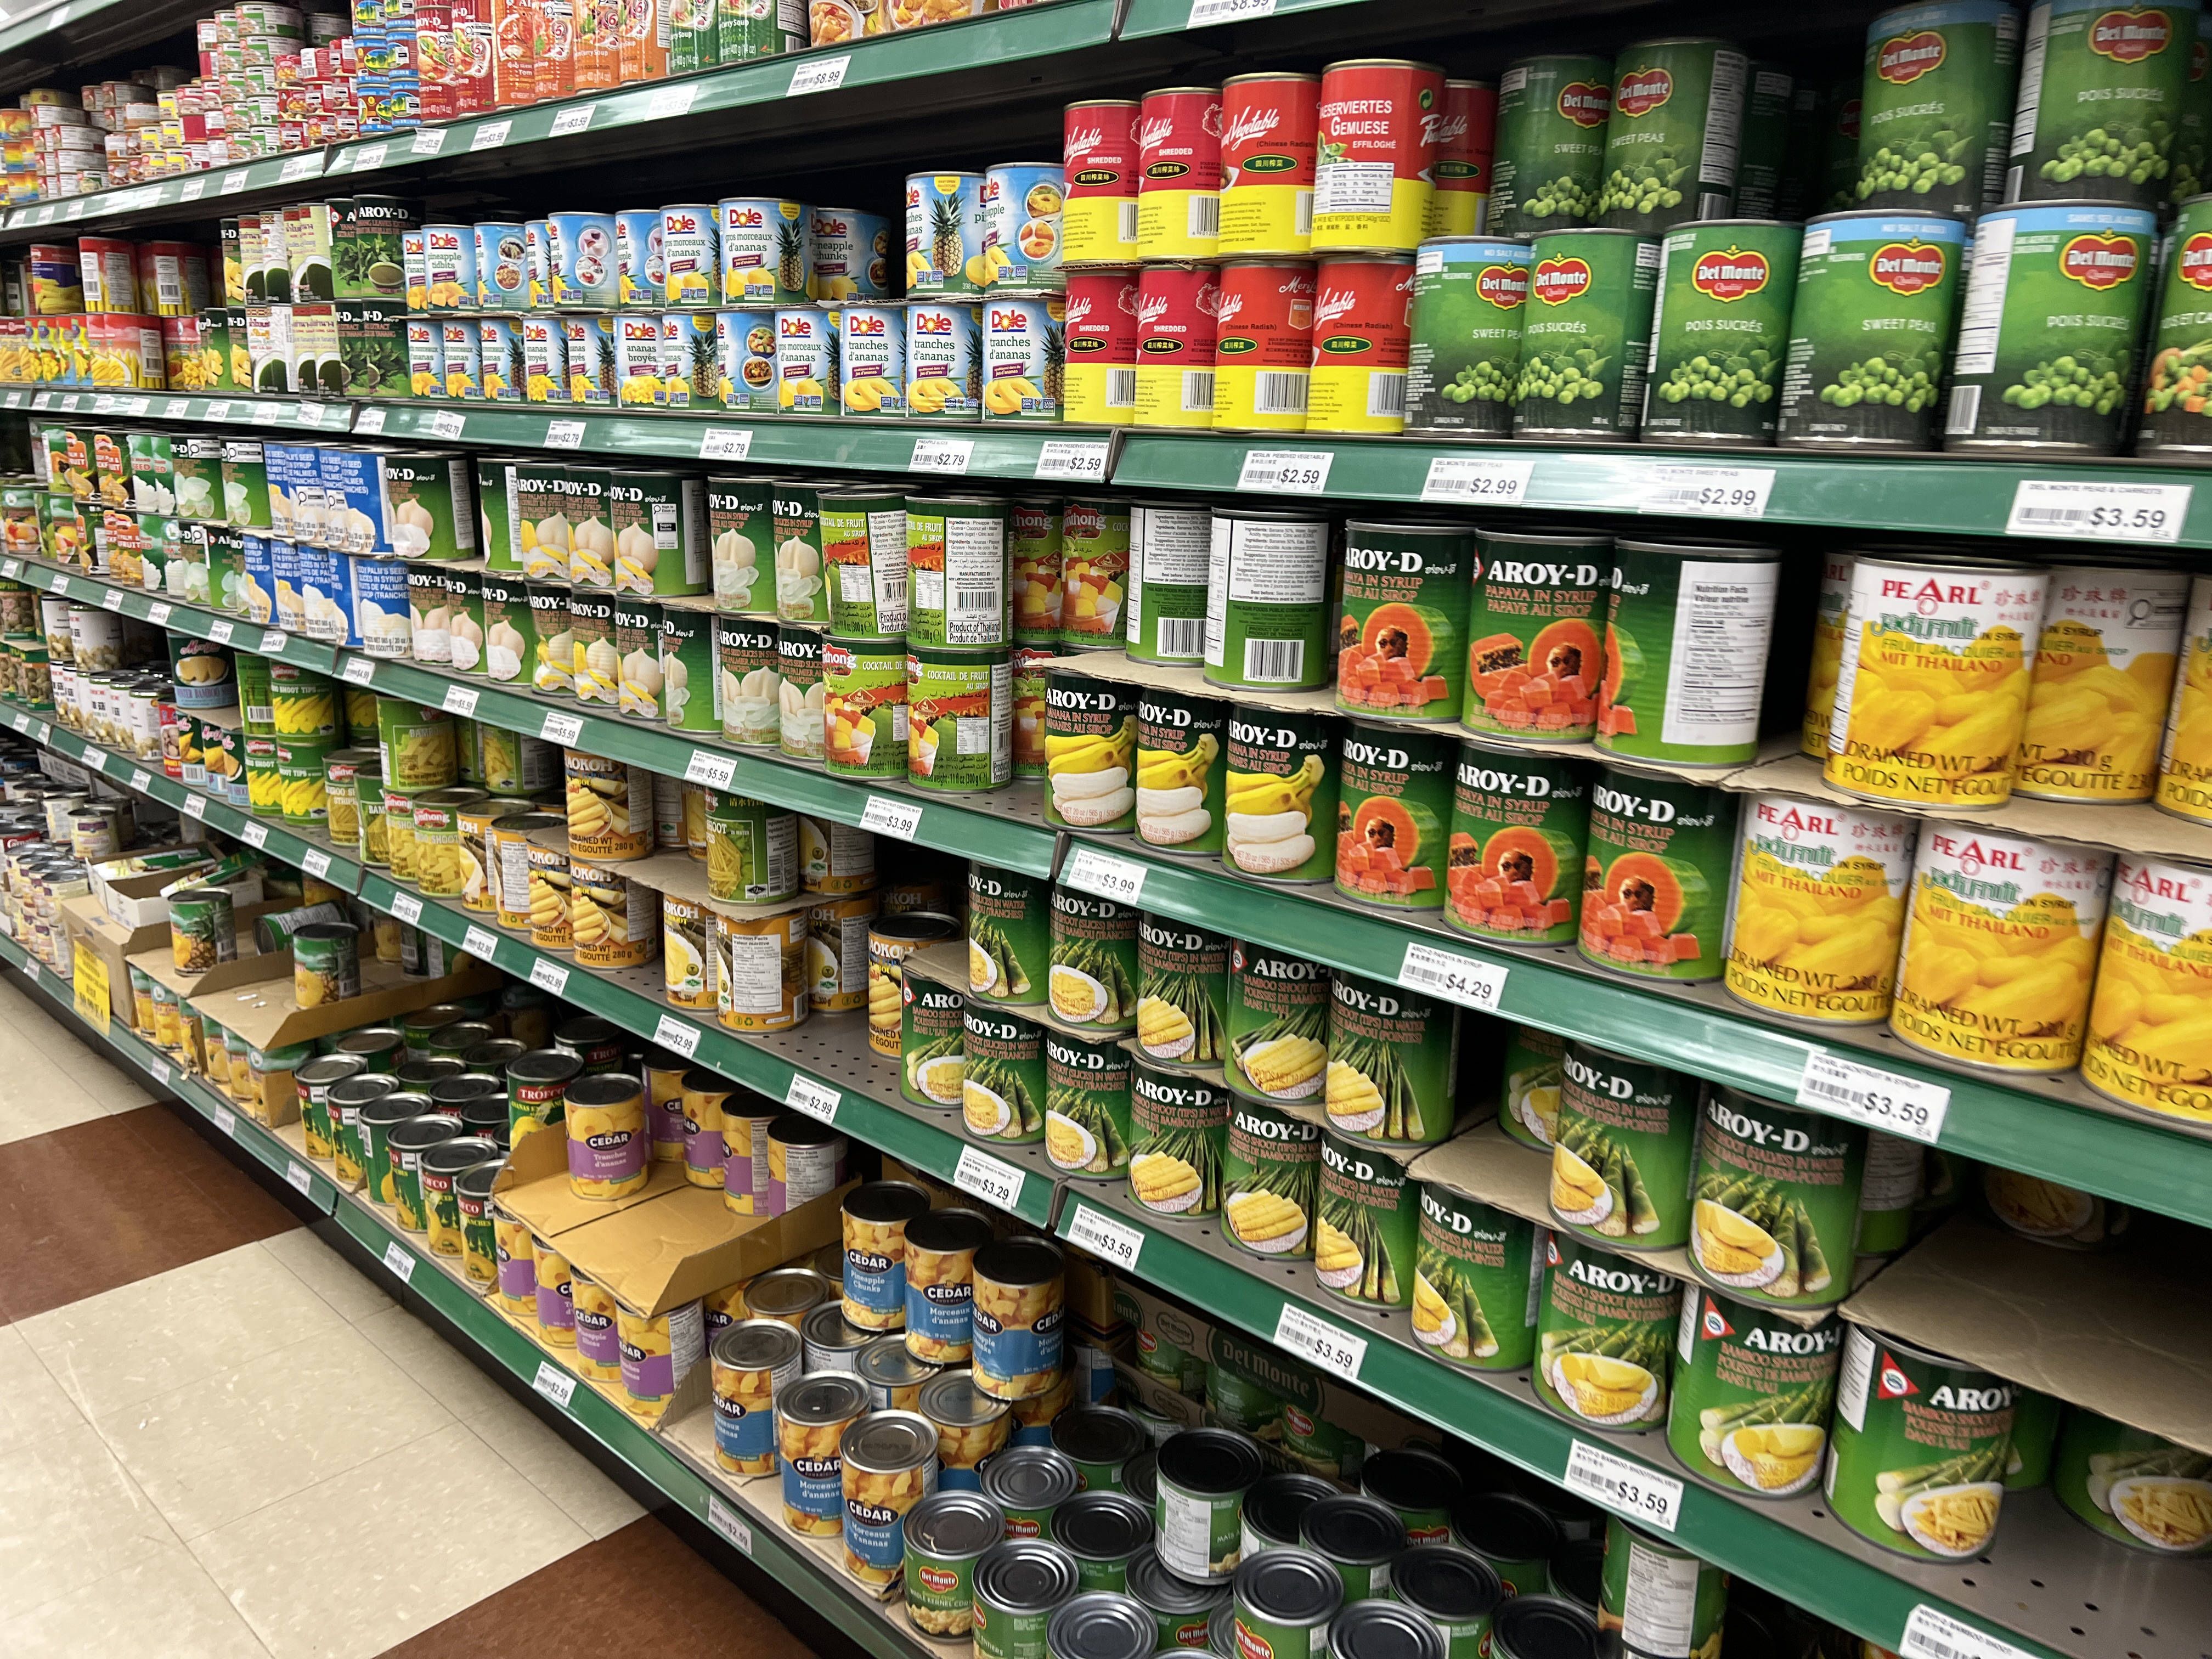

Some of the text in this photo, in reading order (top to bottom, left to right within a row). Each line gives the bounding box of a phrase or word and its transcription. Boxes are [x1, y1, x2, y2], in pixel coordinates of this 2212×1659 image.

[814, 70, 840, 84] $8.99
[1352, 140, 1396, 149] EFFILOGHÉ
[1637, 132, 1665, 144] PEAS
[1159, 148, 1193, 156] SHREDDED
[1554, 144, 1586, 154] SWEET
[359, 207, 408, 218] AROY-D
[730, 208, 763, 225] Dole
[430, 234, 458, 248] Dole
[729, 242, 767, 251] d'ananas
[428, 253, 462, 262] pineapple
[1483, 249, 1494, 257] NO
[1697, 266, 1765, 280] Del Monte
[850, 316, 885, 334] Dole
[917, 313, 952, 332] Dole
[992, 309, 1027, 330] Dole
[1365, 322, 1393, 330] Radish)
[1685, 319, 1762, 332] POIS SUCRÉS
[1861, 319, 1905, 331] SWEET
[625, 323, 656, 338] Dole
[1079, 324, 1110, 332] SHREDDED
[1472, 329, 1522, 338] SWEET PEA
[849, 340, 888, 350] tranches
[915, 338, 955, 349] tranches
[990, 336, 1030, 347] tranches
[628, 353, 657, 364] broyés
[781, 353, 815, 362] d'ananas
[849, 353, 889, 362] d'ananas
[914, 351, 955, 362] d'ananas
[990, 349, 1031, 359] d'ananas
[938, 454, 964, 466] $2.79
[1070, 458, 1101, 471] $2.59
[1280, 469, 1319, 484] $2.59
[1470, 478, 1517, 494] $2.99
[1700, 488, 1756, 505] $2.99
[837, 518, 864, 527] DE FRUIT
[2089, 506, 2165, 528] $3.59
[925, 523, 943, 532] FRUIT
[1346, 547, 1423, 573] AROY-D
[1487, 560, 1599, 586] AROY-D
[1365, 575, 1423, 589] IN SYRUP
[1364, 589, 1418, 602] AU SIROP
[1485, 585, 1598, 606] PAPAYA IN SYRUP
[1882, 578, 1982, 605] PEARL
[1487, 599, 1590, 618] PAPAYE AU SIROP
[950, 622, 972, 633] Product
[973, 622, 979, 631] of
[2048, 625, 2103, 637] IN SYRUP
[1882, 639, 1923, 650] FRUIT
[862, 661, 903, 670] COCKTAIL DE
[1880, 652, 2003, 673] MIT THAILAND
[928, 672, 988, 681] COCKTAIL DE FRUIT
[1046, 687, 1116, 710] AROY-D
[1072, 713, 1111, 724] IN SYRUP
[557, 727, 575, 740] $5.59
[1073, 723, 1114, 734] AU SIROP
[1229, 719, 1297, 748] AROY-D
[1249, 749, 1290, 763] IN SYRUP
[1249, 760, 1292, 774] AU SIROP
[707, 768, 729, 782] $5.59
[1457, 763, 1550, 797] AROY-D
[1486, 795, 1550, 814] IN SYRUP
[887, 815, 912, 832] $3.99
[1756, 802, 1839, 836] PEARL
[601, 838, 613, 846] WT
[1932, 834, 2025, 872] PEARL
[1102, 873, 1135, 894] $3.99
[994, 899, 1026, 910] IN WATER
[1051, 891, 1116, 918] AROY-D
[1928, 905, 2050, 940] MIT THAILAND
[1446, 974, 1492, 999] $4.29
[1731, 967, 1813, 1009] POIDS NET
[940, 1010, 963, 1020] SHOOT
[1898, 1008, 1988, 1056] POIDS NET
[673, 1032, 692, 1049] $2.99
[809, 1097, 833, 1115] $2.99
[1865, 1091, 1929, 1127] $3.59
[1234, 1111, 1318, 1142] AROY-D
[1707, 1098, 1810, 1152] AROY-D
[589, 1133, 628, 1147] CEDAR
[593, 1152, 627, 1160] Tranches
[595, 1159, 627, 1167] d'ananas
[982, 1179, 1009, 1200] $3.29
[1101, 1233, 1133, 1260] $3.59
[849, 1251, 887, 1269] CEDAR
[851, 1271, 885, 1284] Pineapple
[1568, 1259, 1675, 1294] AROY-D
[853, 1280, 881, 1293] Chunks
[928, 1286, 972, 1299] CEDAR
[930, 1307, 970, 1316] Morceaux
[575, 1311, 608, 1329] CEDAR
[932, 1316, 968, 1324] d'ananas
[1314, 1339, 1353, 1368] $3.59
[549, 1380, 568, 1400] $2.59
[802, 1490, 840, 1499] d'ananas
[1616, 1481, 1668, 1515] $3.59
[849, 1501, 893, 1521] CEDAR
[851, 1522, 890, 1539] Morceaux
[921, 1571, 955, 1585] Del Monte
